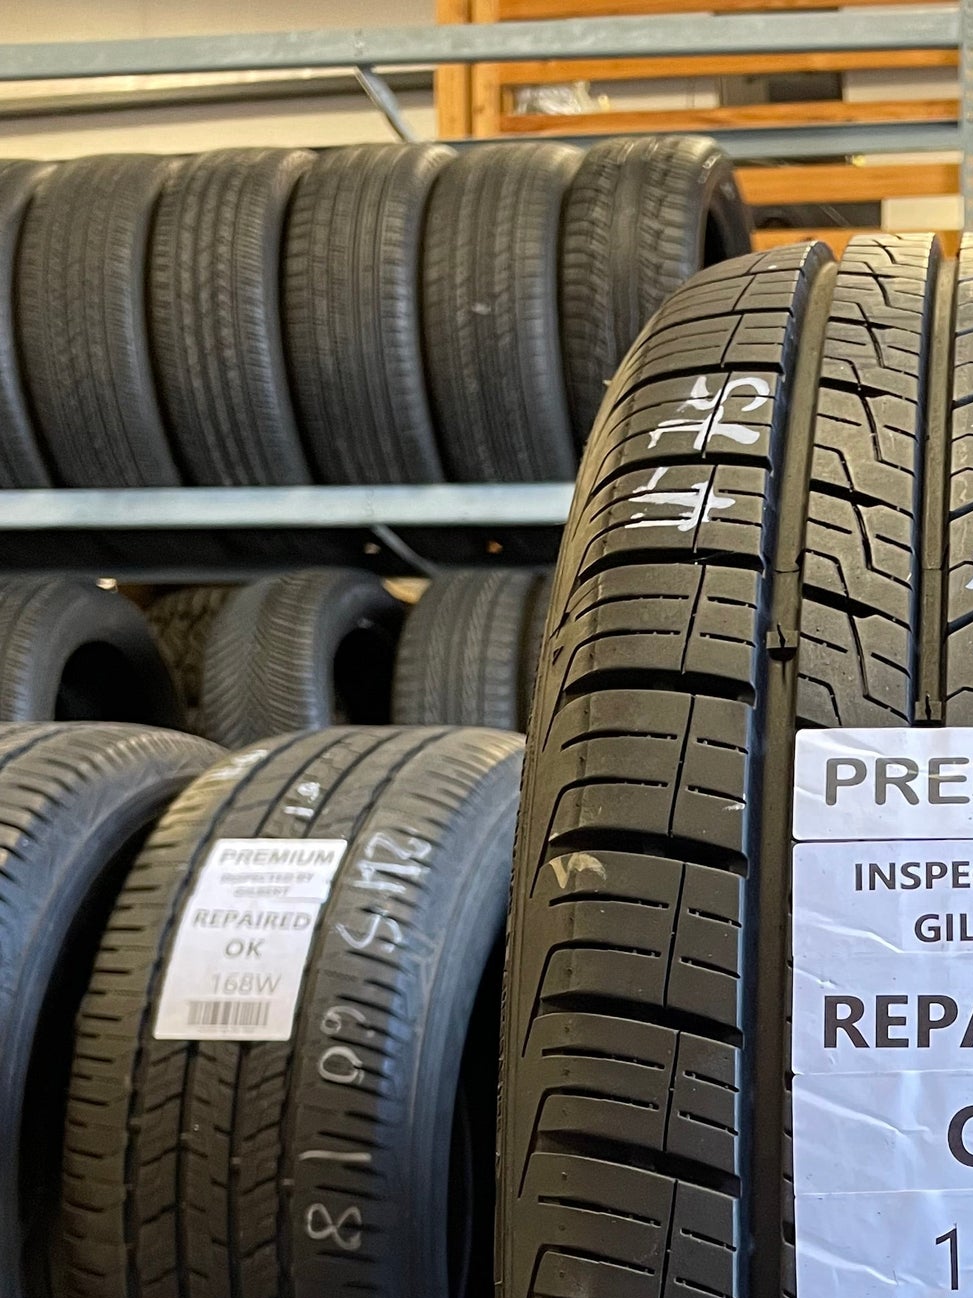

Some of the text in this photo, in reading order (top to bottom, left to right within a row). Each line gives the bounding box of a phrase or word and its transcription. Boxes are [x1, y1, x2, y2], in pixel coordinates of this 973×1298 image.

[219, 848, 336, 867] PREMIUM
[193, 908, 312, 931] REPAIRED
[223, 938, 266, 961] OK
[211, 972, 284, 996] 168W
